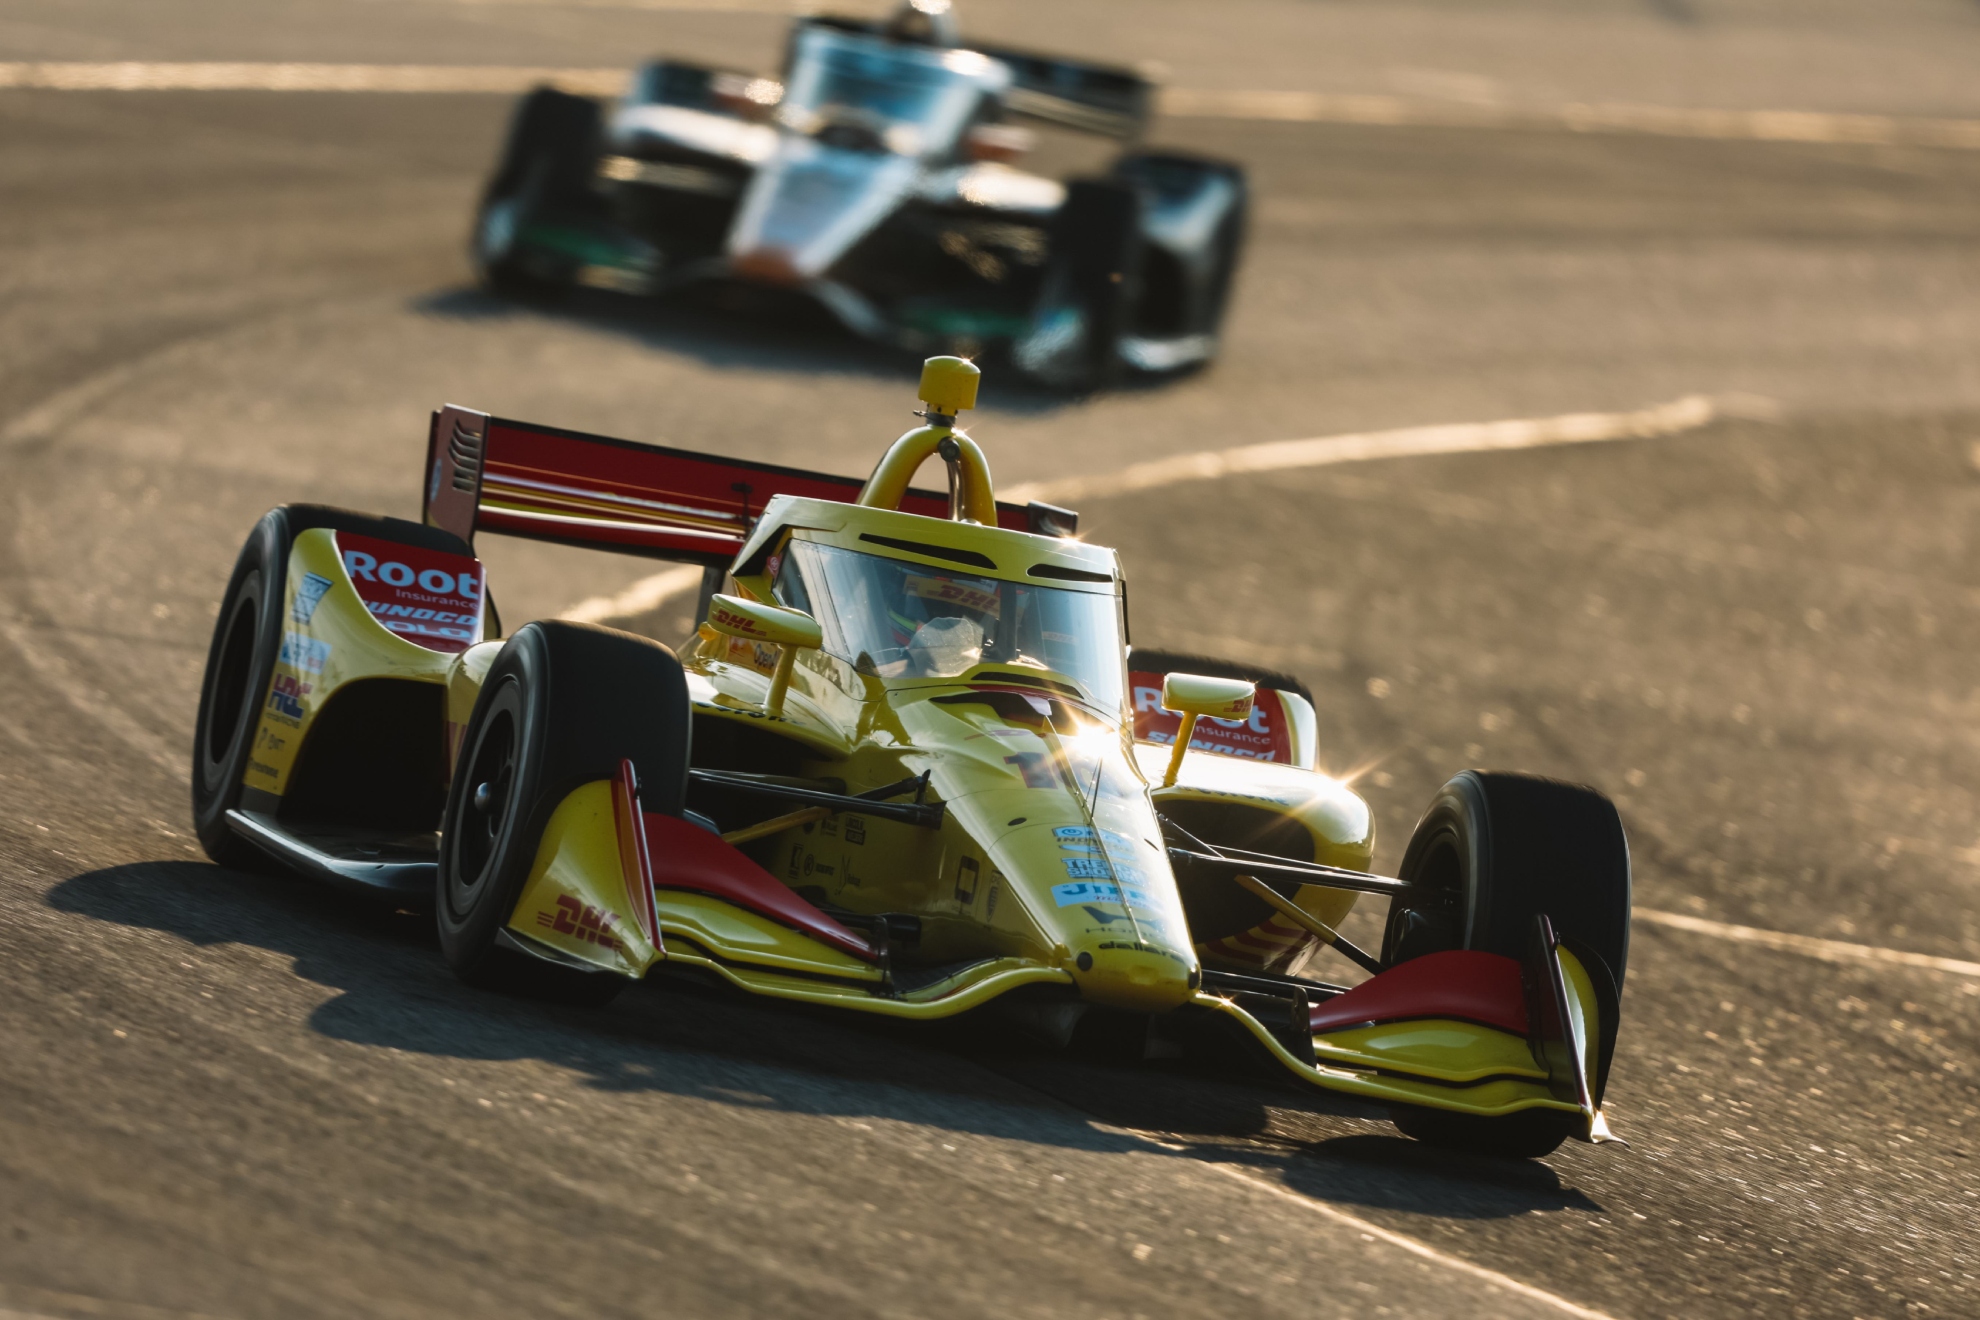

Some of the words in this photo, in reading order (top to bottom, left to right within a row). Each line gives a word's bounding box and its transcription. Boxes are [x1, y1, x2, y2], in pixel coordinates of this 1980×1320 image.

[396, 589, 479, 610] Insurance
[936, 584, 1000, 615] DHL
[712, 609, 757, 635] DHL
[1194, 725, 1271, 745] nsurance
[552, 894, 621, 949] DHL
